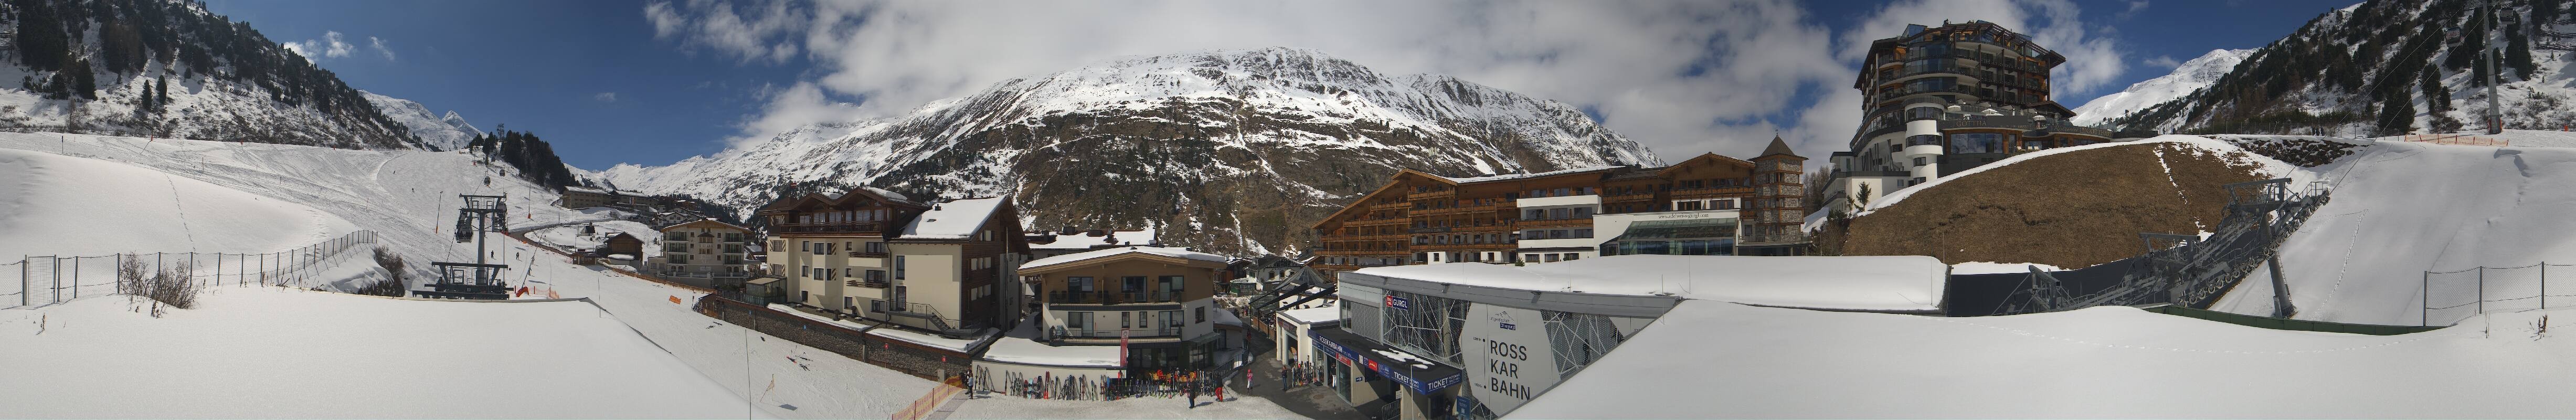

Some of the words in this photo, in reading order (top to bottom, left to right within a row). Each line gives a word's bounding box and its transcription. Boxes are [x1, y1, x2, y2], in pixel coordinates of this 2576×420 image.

[1393, 299, 1407, 308] GURGL
[1319, 336, 1343, 353] ROSSKARBAHN
[1490, 340, 1527, 361] ROSS
[1394, 371, 1409, 384] TICKET
[1491, 359, 1518, 379] KAR
[1428, 377, 1448, 390] TICKET
[1491, 377, 1530, 401] BAHN
